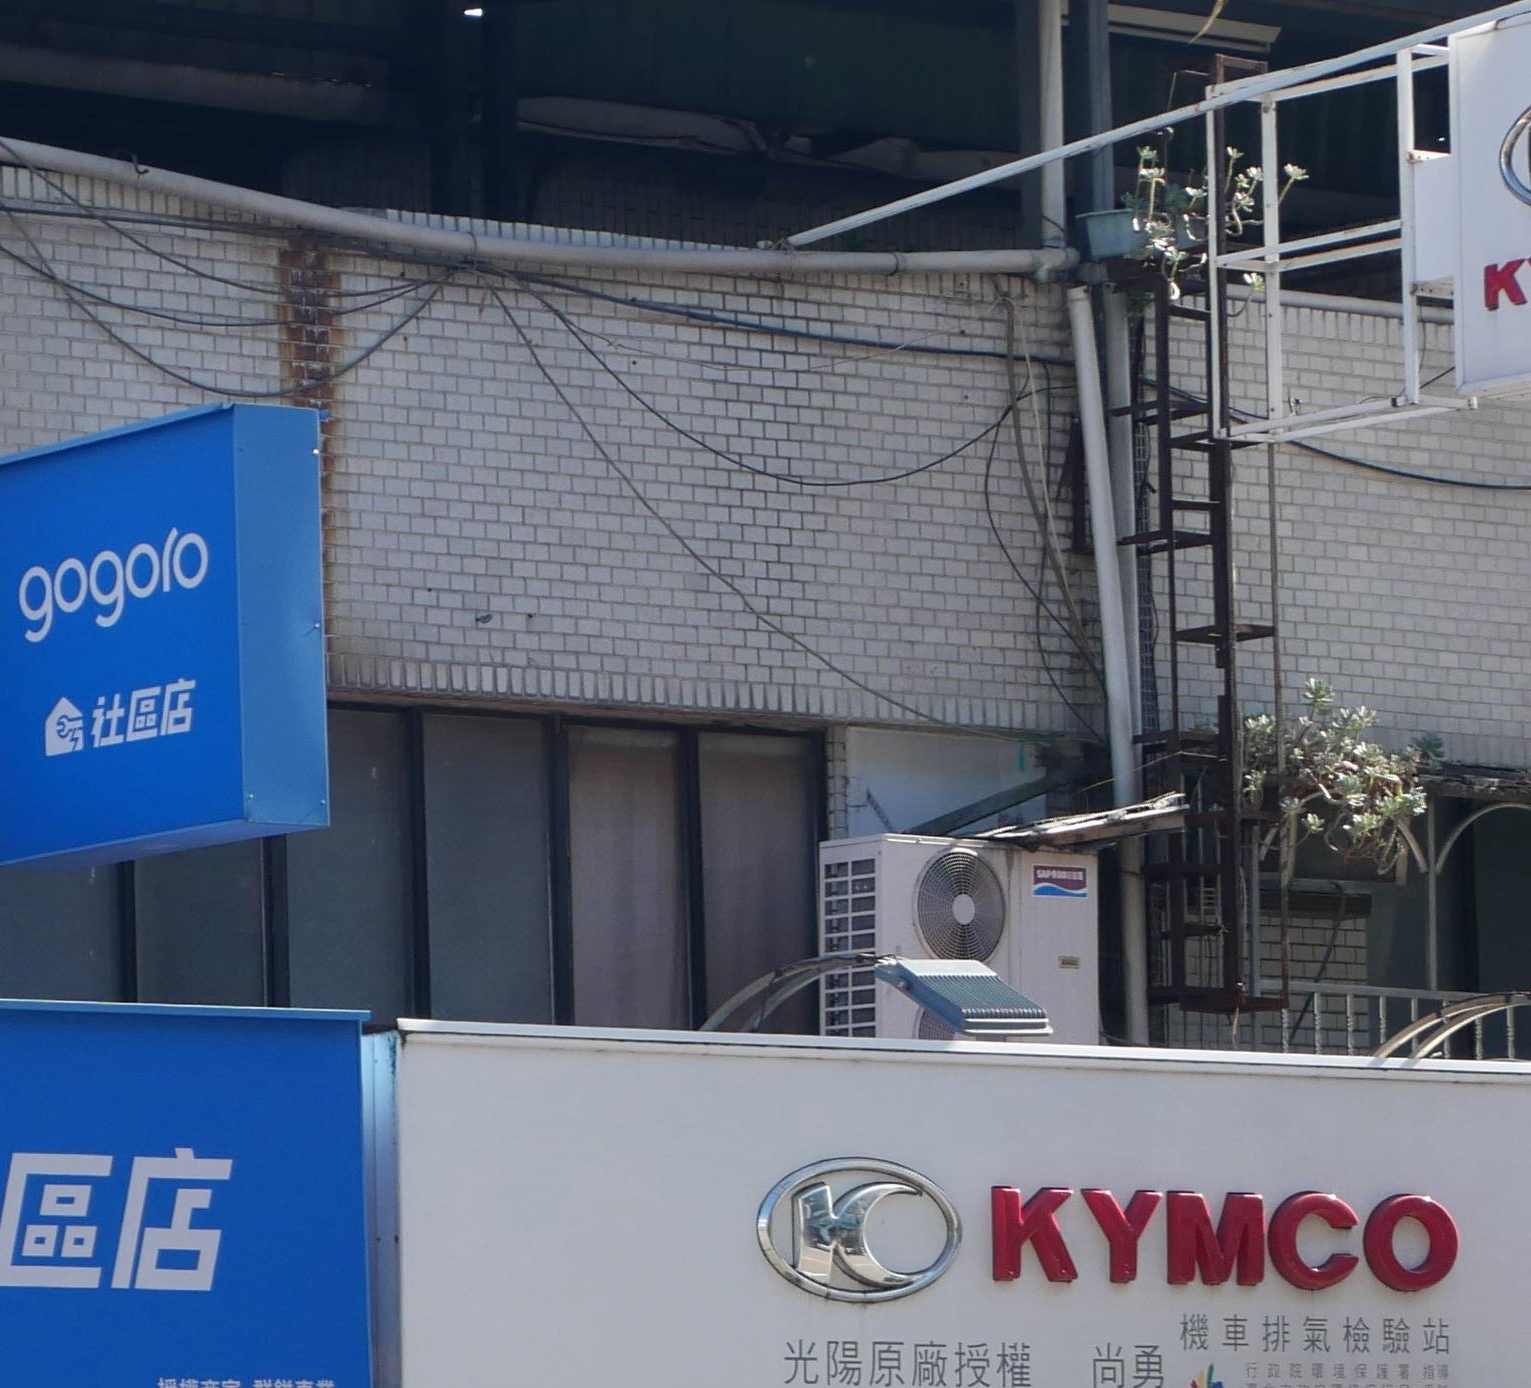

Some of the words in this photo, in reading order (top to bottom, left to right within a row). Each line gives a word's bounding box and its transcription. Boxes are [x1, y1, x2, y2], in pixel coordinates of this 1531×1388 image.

[1483, 257, 1531, 311] K
[19, 527, 209, 643] gogoro
[91, 678, 196, 748] 社區店
[991, 1184, 1459, 1293] KYMCO
[1180, 1313, 1450, 1354] 機車排氣檢驗站
